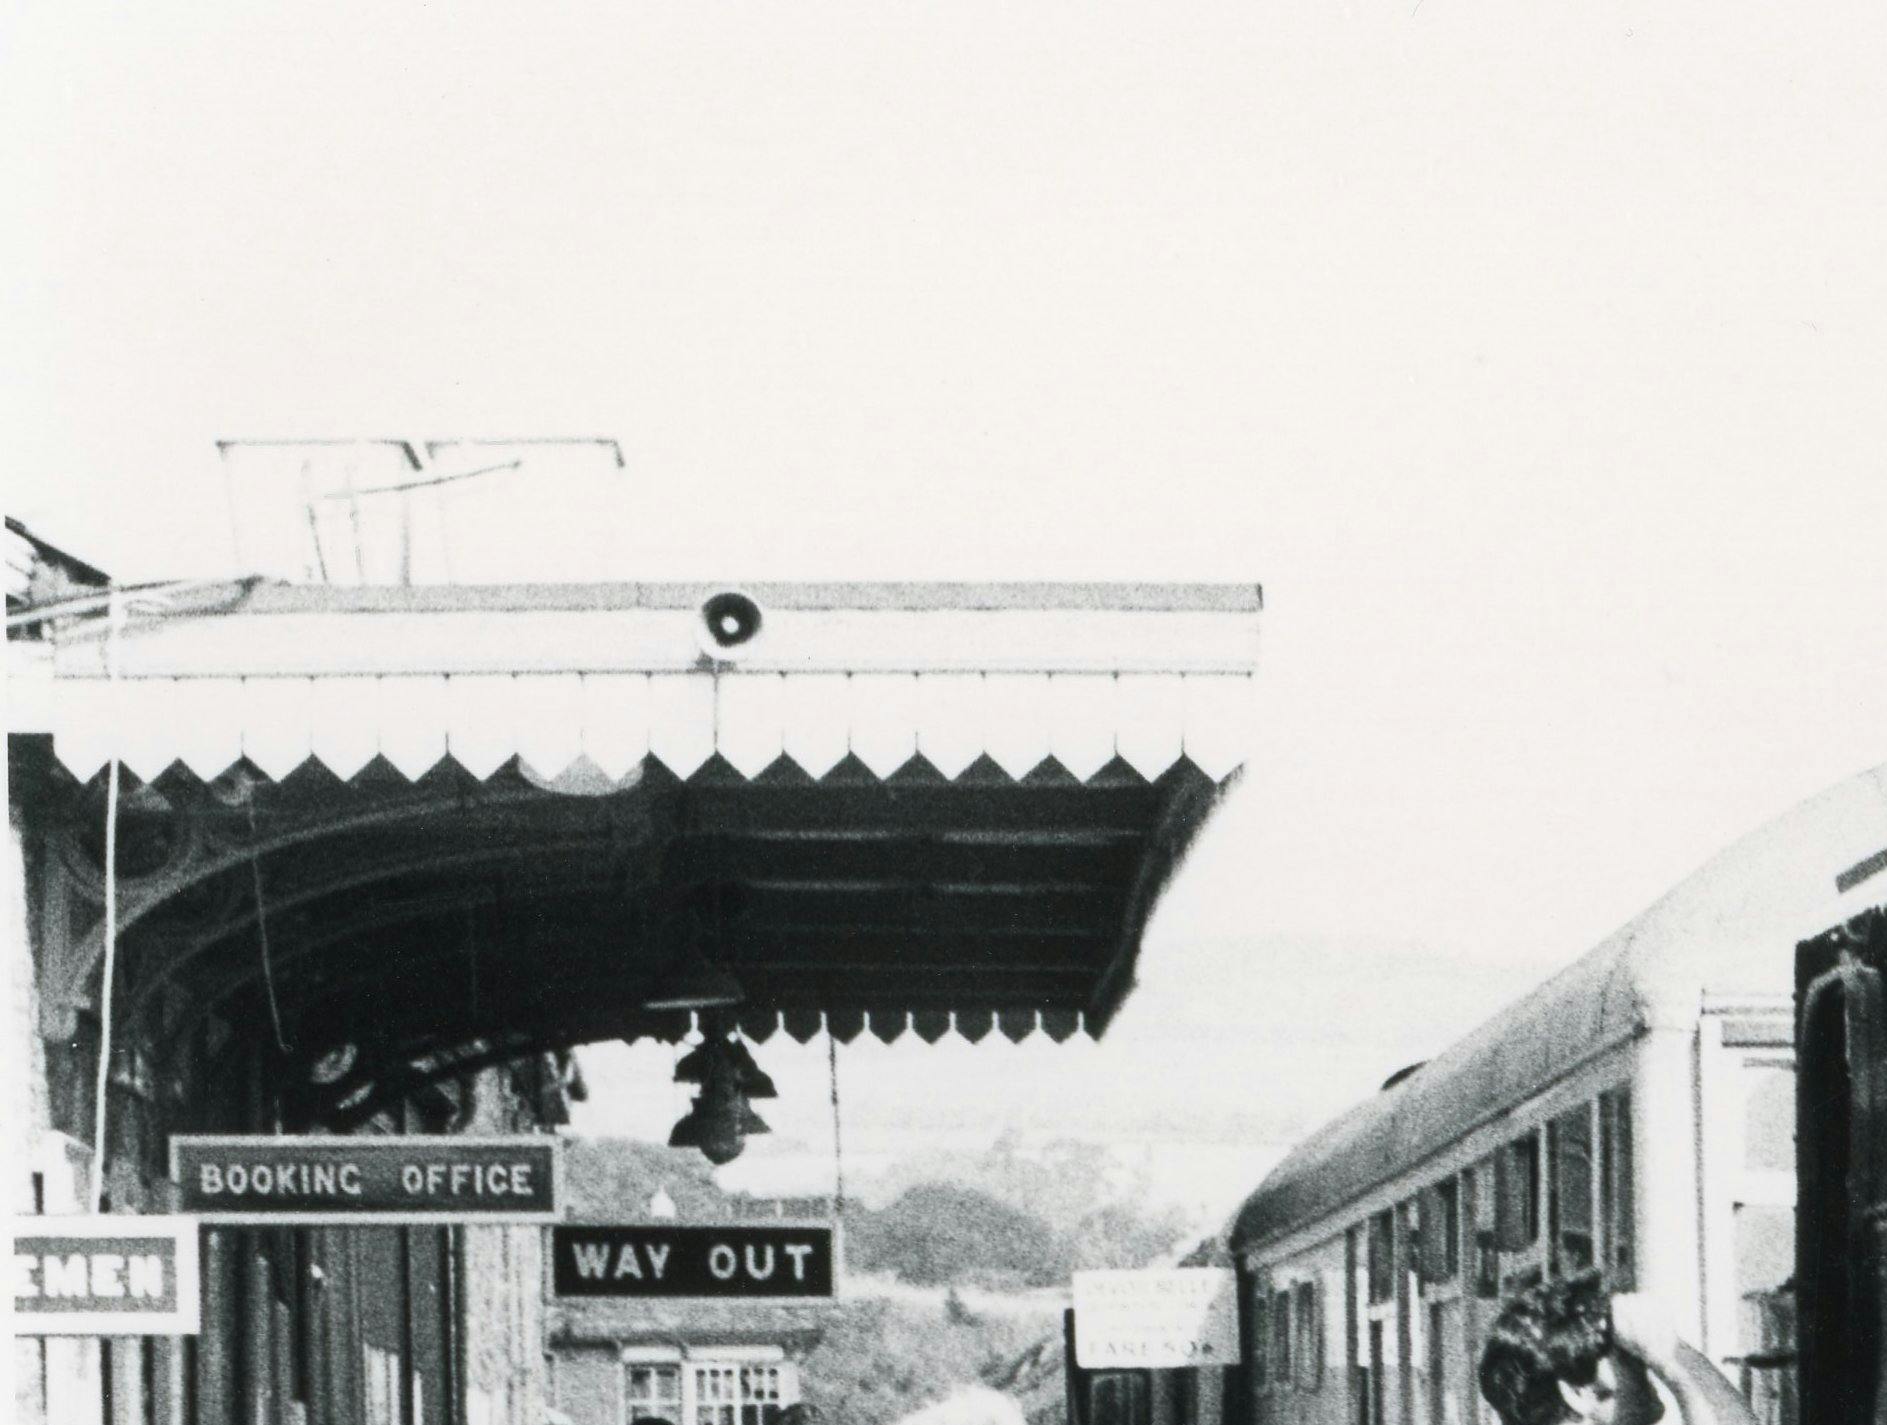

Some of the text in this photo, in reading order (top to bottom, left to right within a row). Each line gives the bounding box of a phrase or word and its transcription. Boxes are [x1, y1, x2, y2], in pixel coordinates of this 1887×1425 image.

[199, 1163, 533, 1195] BOOKING OFFICE
[572, 1243, 812, 1280] WAY OUT
